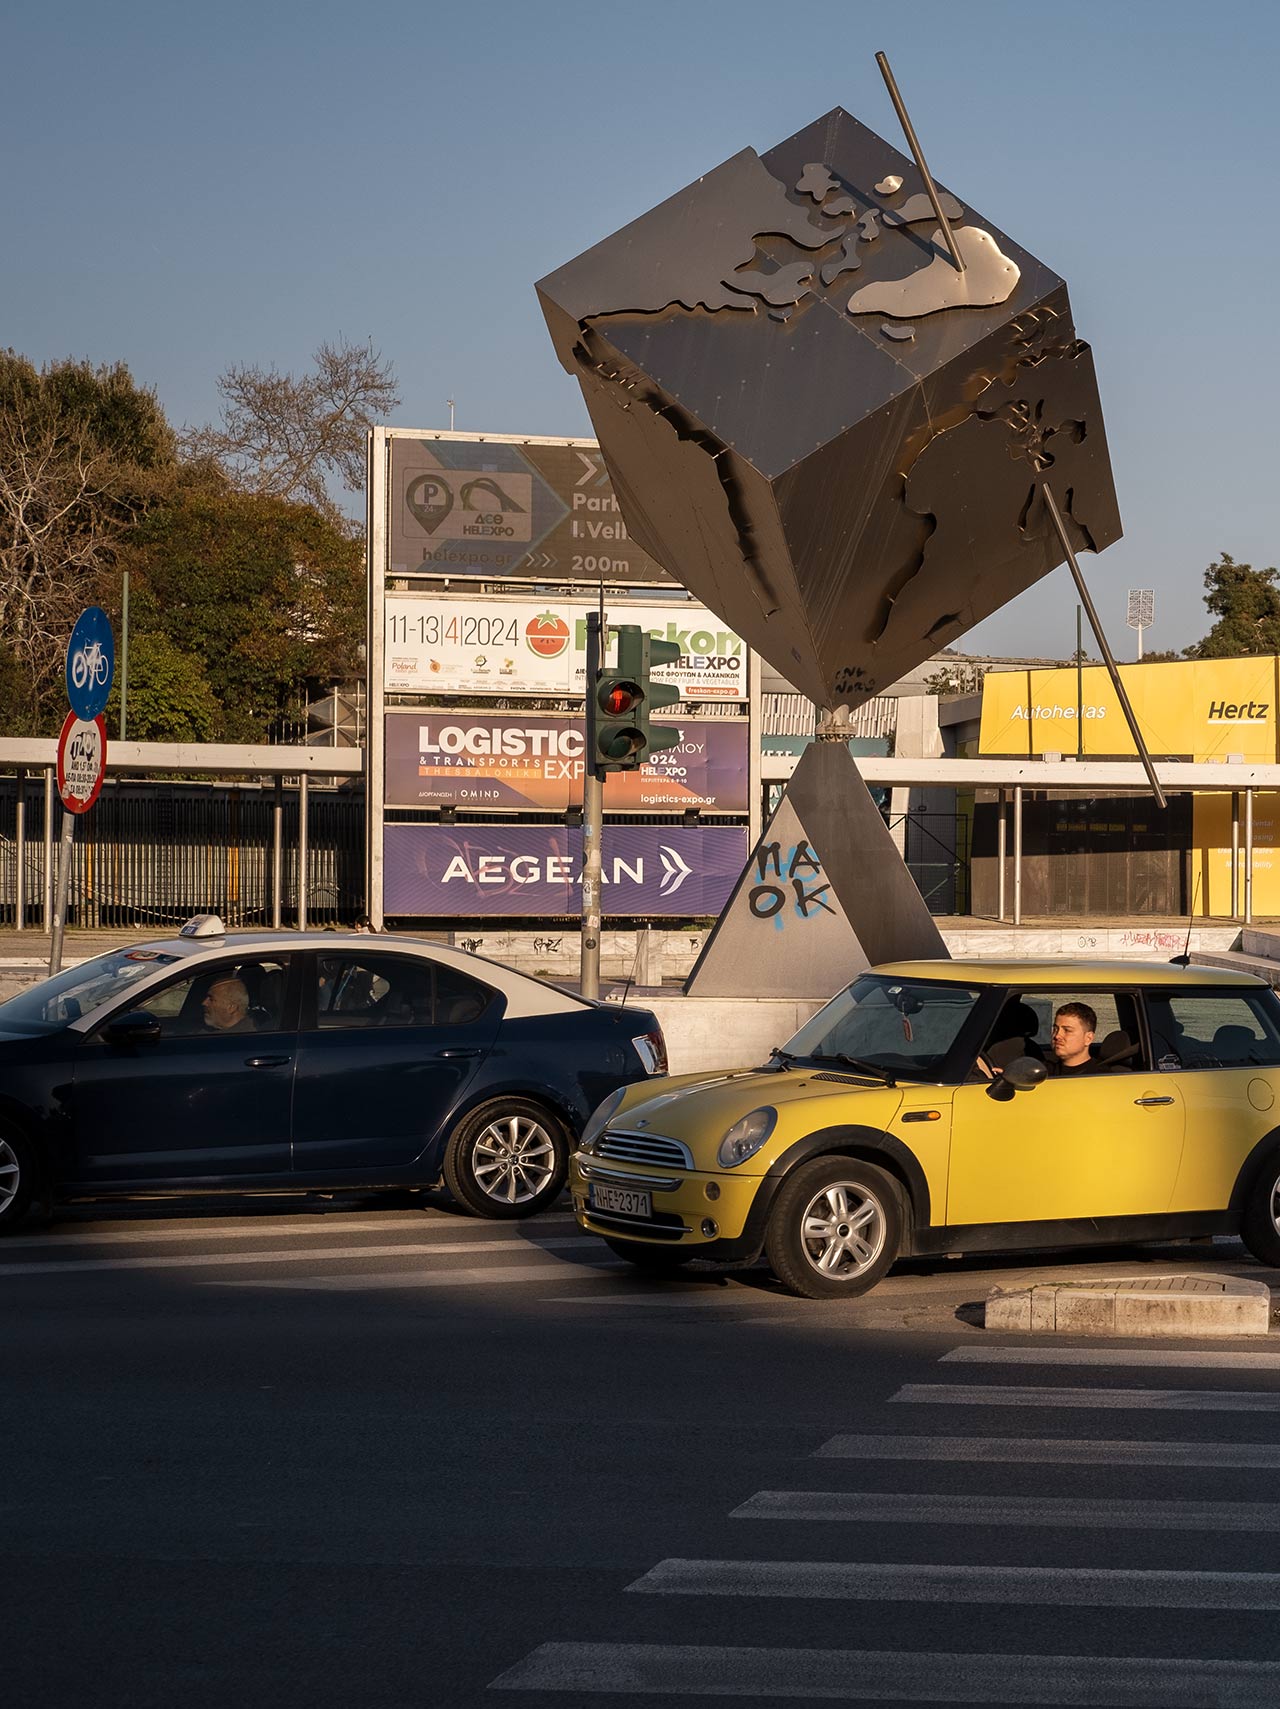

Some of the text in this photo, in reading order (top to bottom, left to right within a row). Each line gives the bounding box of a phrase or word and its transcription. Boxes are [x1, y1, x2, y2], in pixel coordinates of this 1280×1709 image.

[423, 484, 438, 503] P
[572, 493, 621, 512] Park
[463, 526, 515, 537] HELEXPO
[423, 548, 513, 566] helexpo.gr
[572, 556, 629, 572] 200m
[391, 662, 417, 670] Poland
[702, 679, 740, 687] VEGETABLES
[688, 687, 738, 696] freskon-expo.gr
[1208, 701, 1269, 719] Hertz
[418, 726, 585, 757] LOGISTIC
[419, 756, 541, 767] & TRANSPORTS
[650, 755, 677, 764] 024
[424, 767, 539, 777] THESSALONIKI
[544, 760, 585, 779] EXP
[641, 767, 687, 776] HELEXPO
[460, 789, 500, 798] OMIND
[641, 794, 716, 805] logistics-expo.gr
[440, 855, 643, 884] AEGEN
